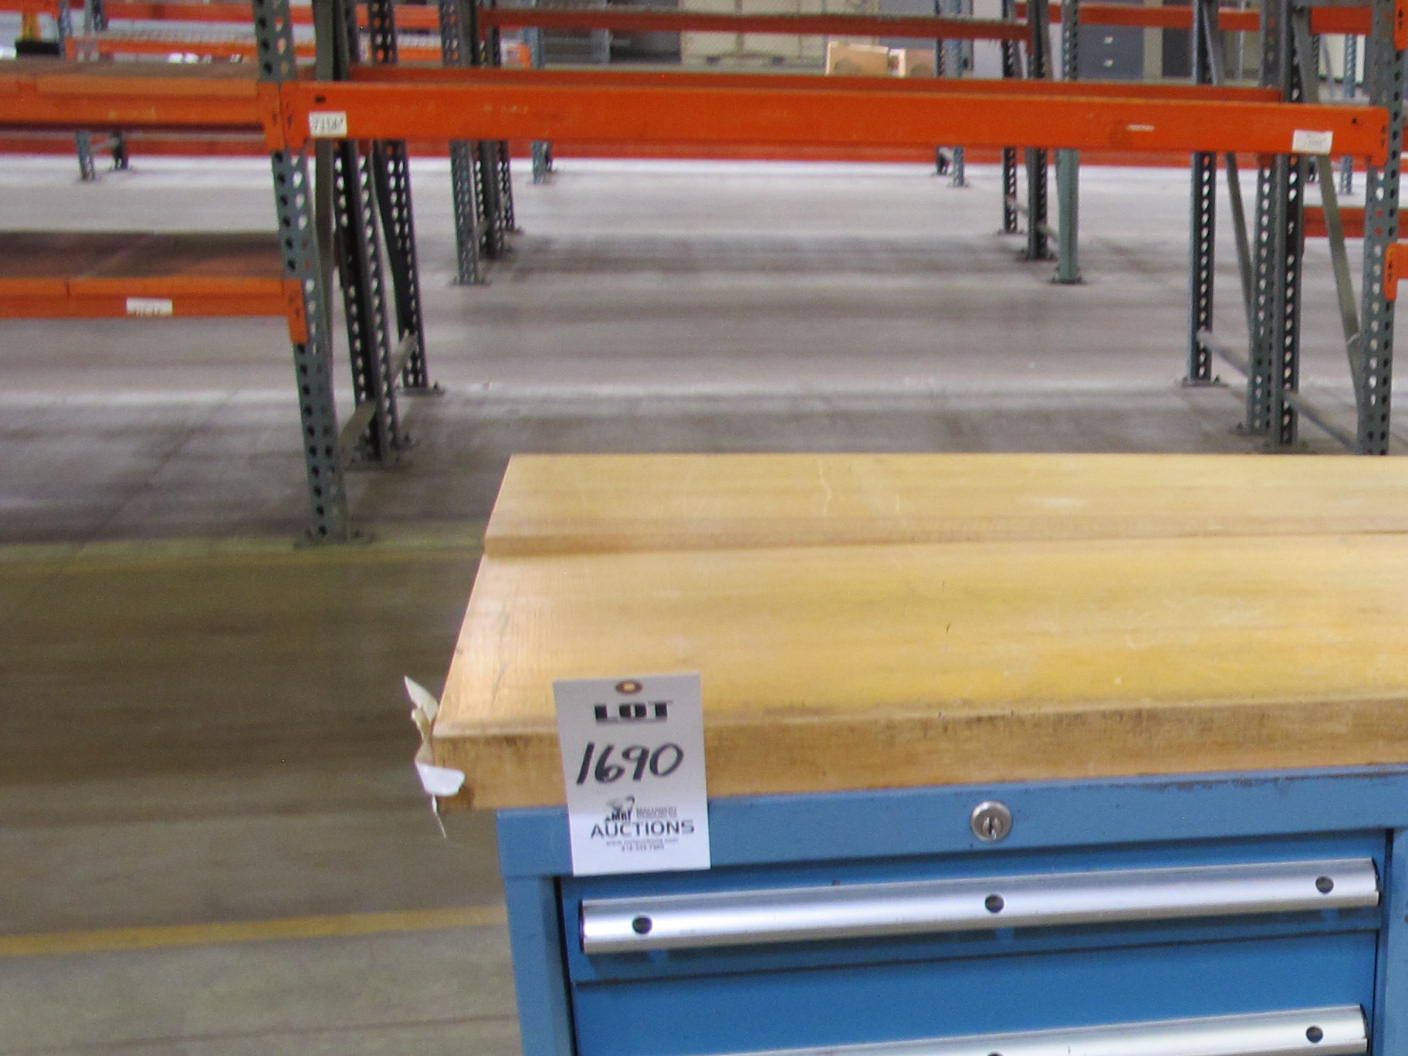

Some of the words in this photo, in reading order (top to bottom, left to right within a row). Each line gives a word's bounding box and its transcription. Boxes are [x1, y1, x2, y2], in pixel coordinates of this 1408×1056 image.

[593, 700, 672, 723] LOT
[575, 741, 684, 786] 1690
[591, 818, 695, 840] AUCTIONS
